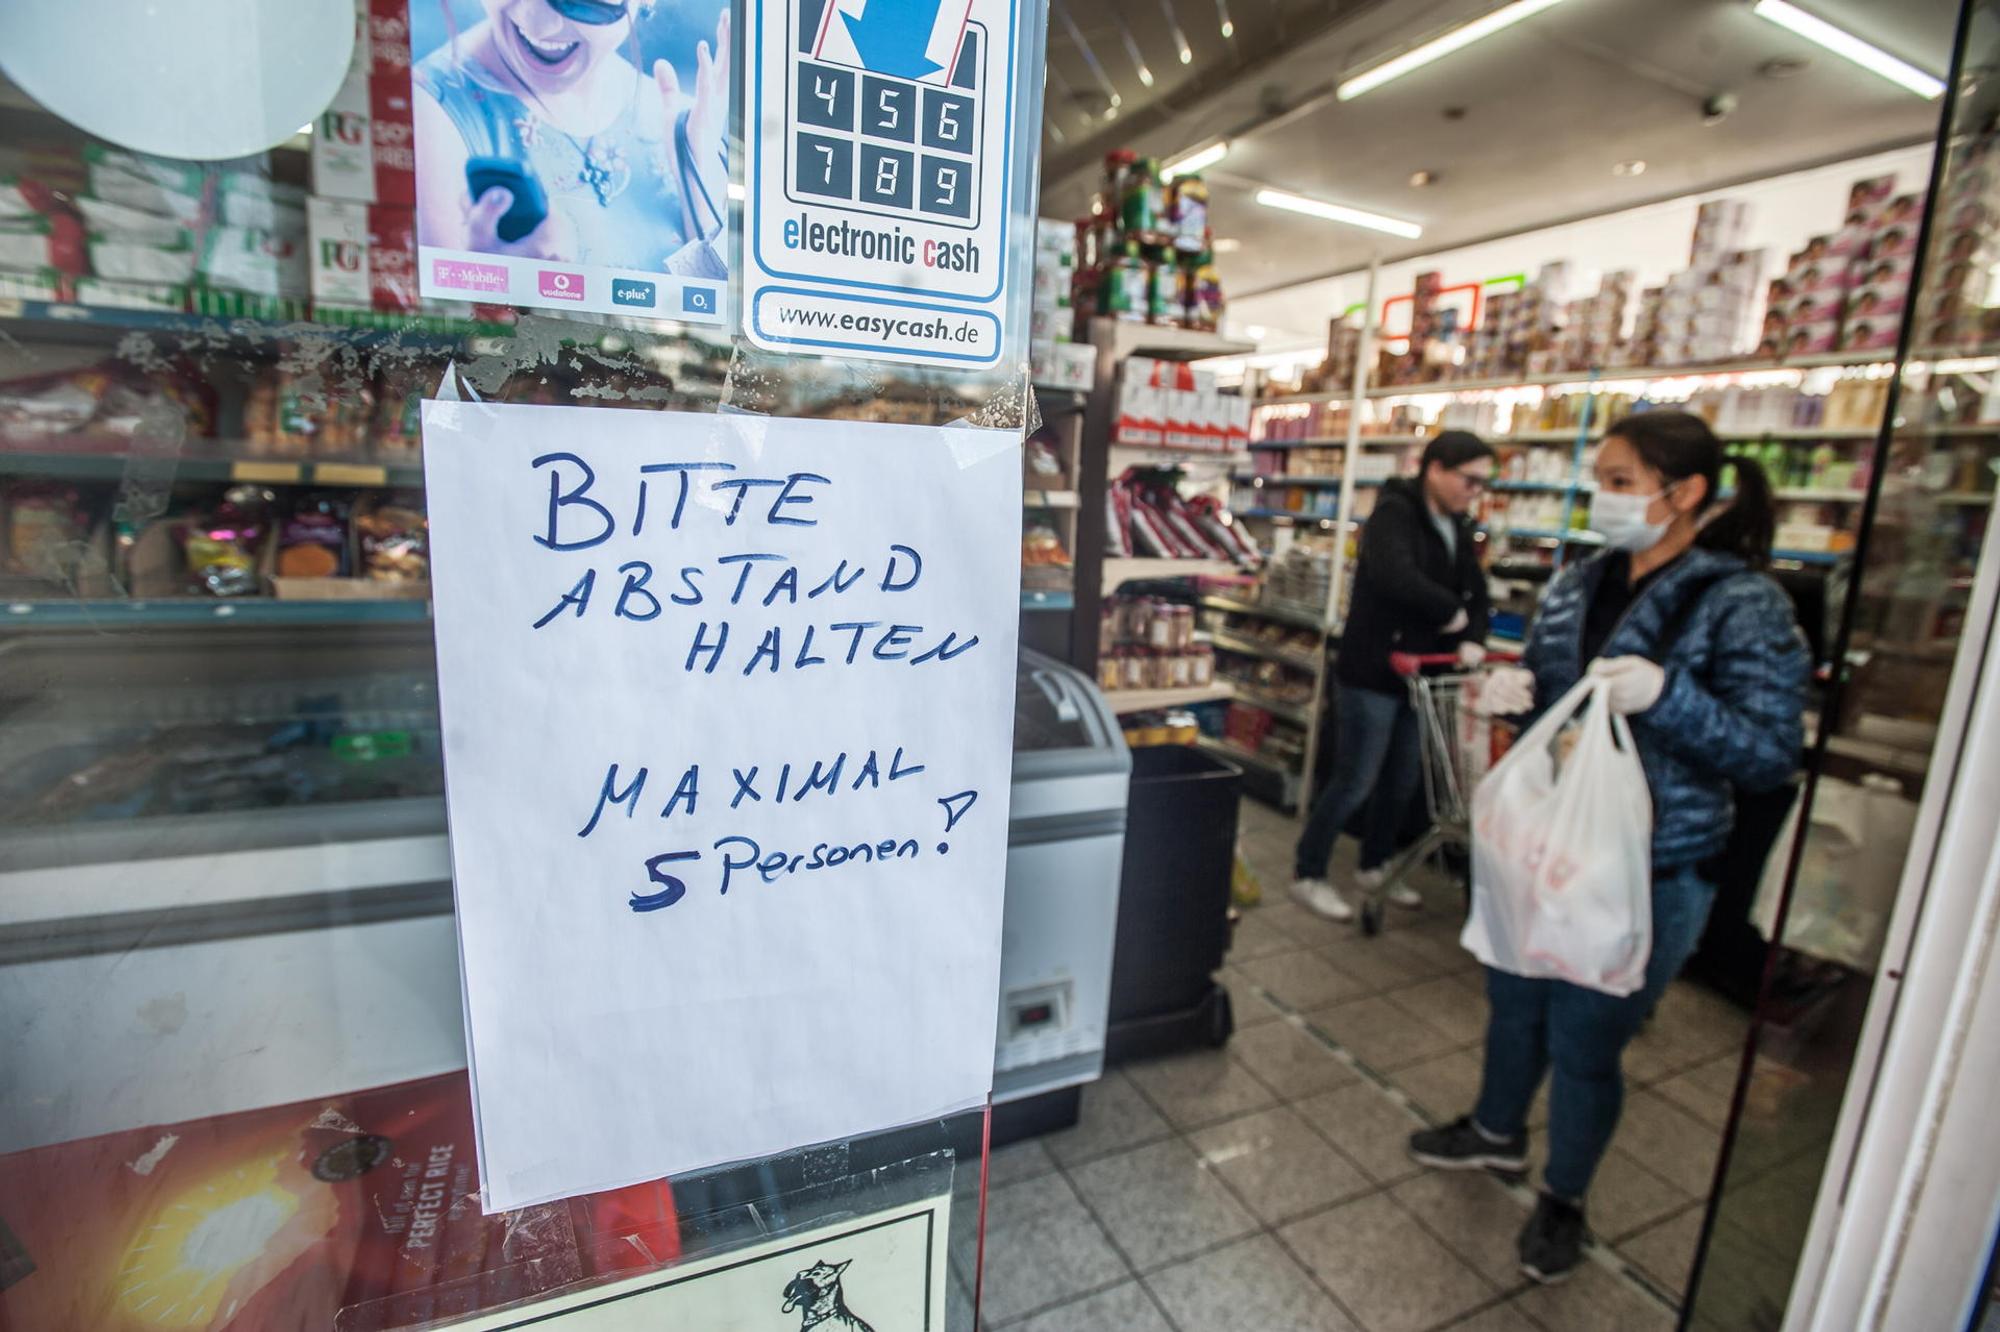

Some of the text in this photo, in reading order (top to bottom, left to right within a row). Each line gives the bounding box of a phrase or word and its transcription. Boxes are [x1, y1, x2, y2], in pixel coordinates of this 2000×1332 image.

[815, 76, 960, 141] 4 5 6
[814, 144, 958, 206] 7 8 9
[783, 212, 979, 273] electronic cash
[542, 288, 582, 299] vodafone
[778, 306, 979, 344] www.easycash.de
[532, 452, 831, 551] BITTE
[533, 544, 922, 630] ABSTAND
[685, 621, 979, 676] HALTEN
[577, 746, 926, 838] MAXIMAL
[628, 849, 701, 913] 5
[406, 1144, 455, 1249] PERFECT RICE
